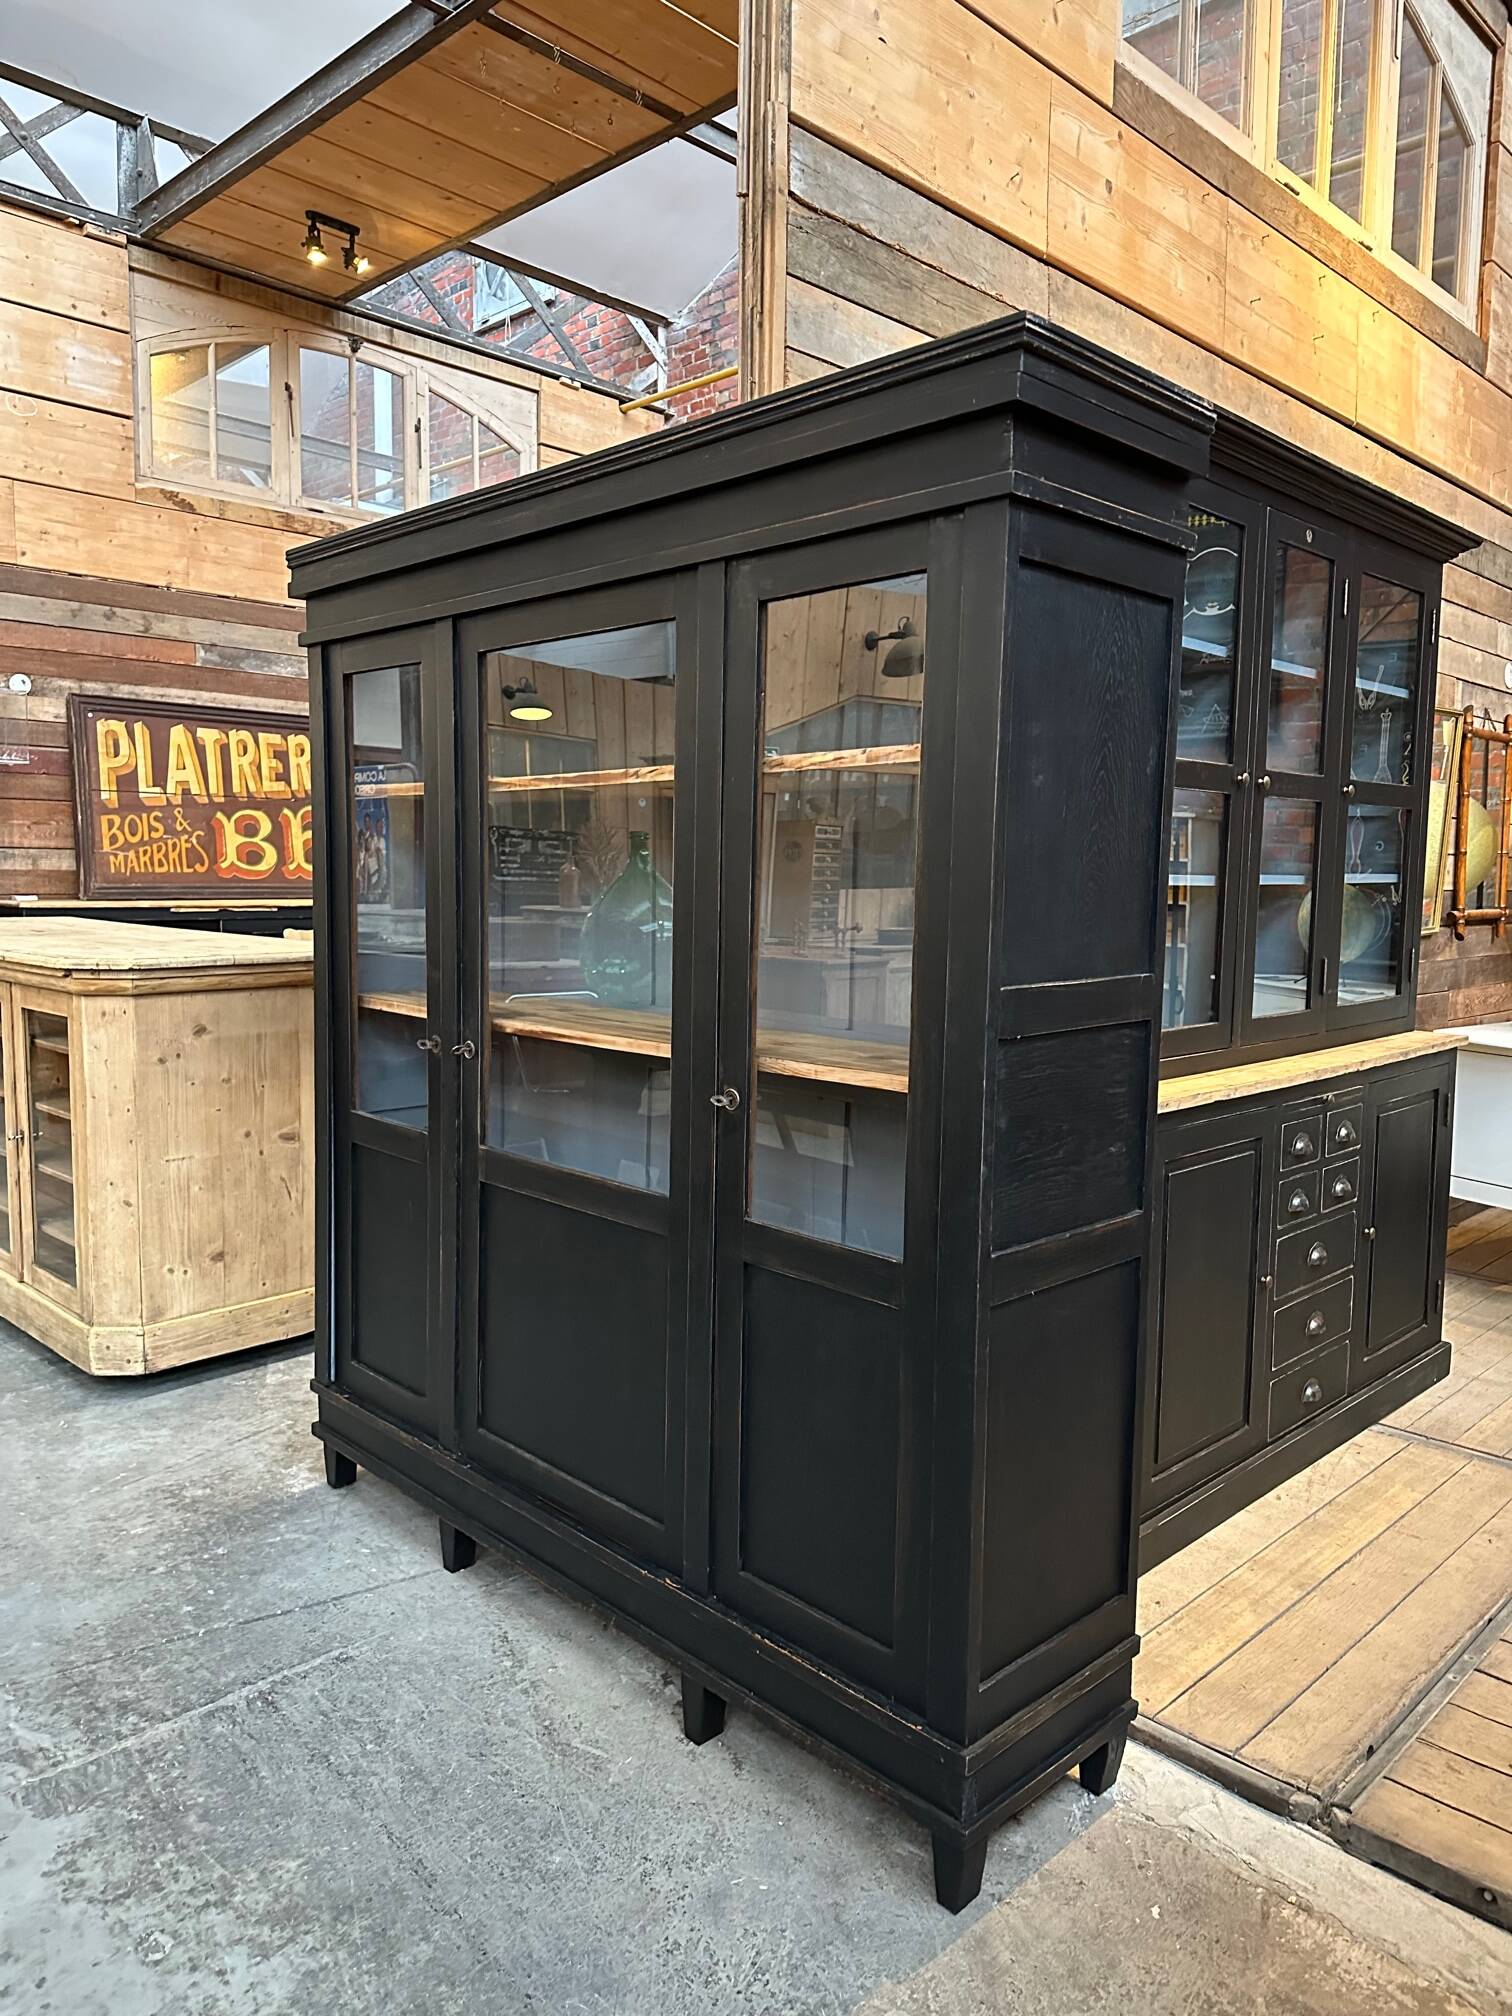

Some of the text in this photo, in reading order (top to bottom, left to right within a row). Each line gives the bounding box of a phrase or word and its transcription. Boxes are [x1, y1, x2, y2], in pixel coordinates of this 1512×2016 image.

[100, 807, 192, 851] BOIS &
[109, 831, 209, 876] MARBRES
